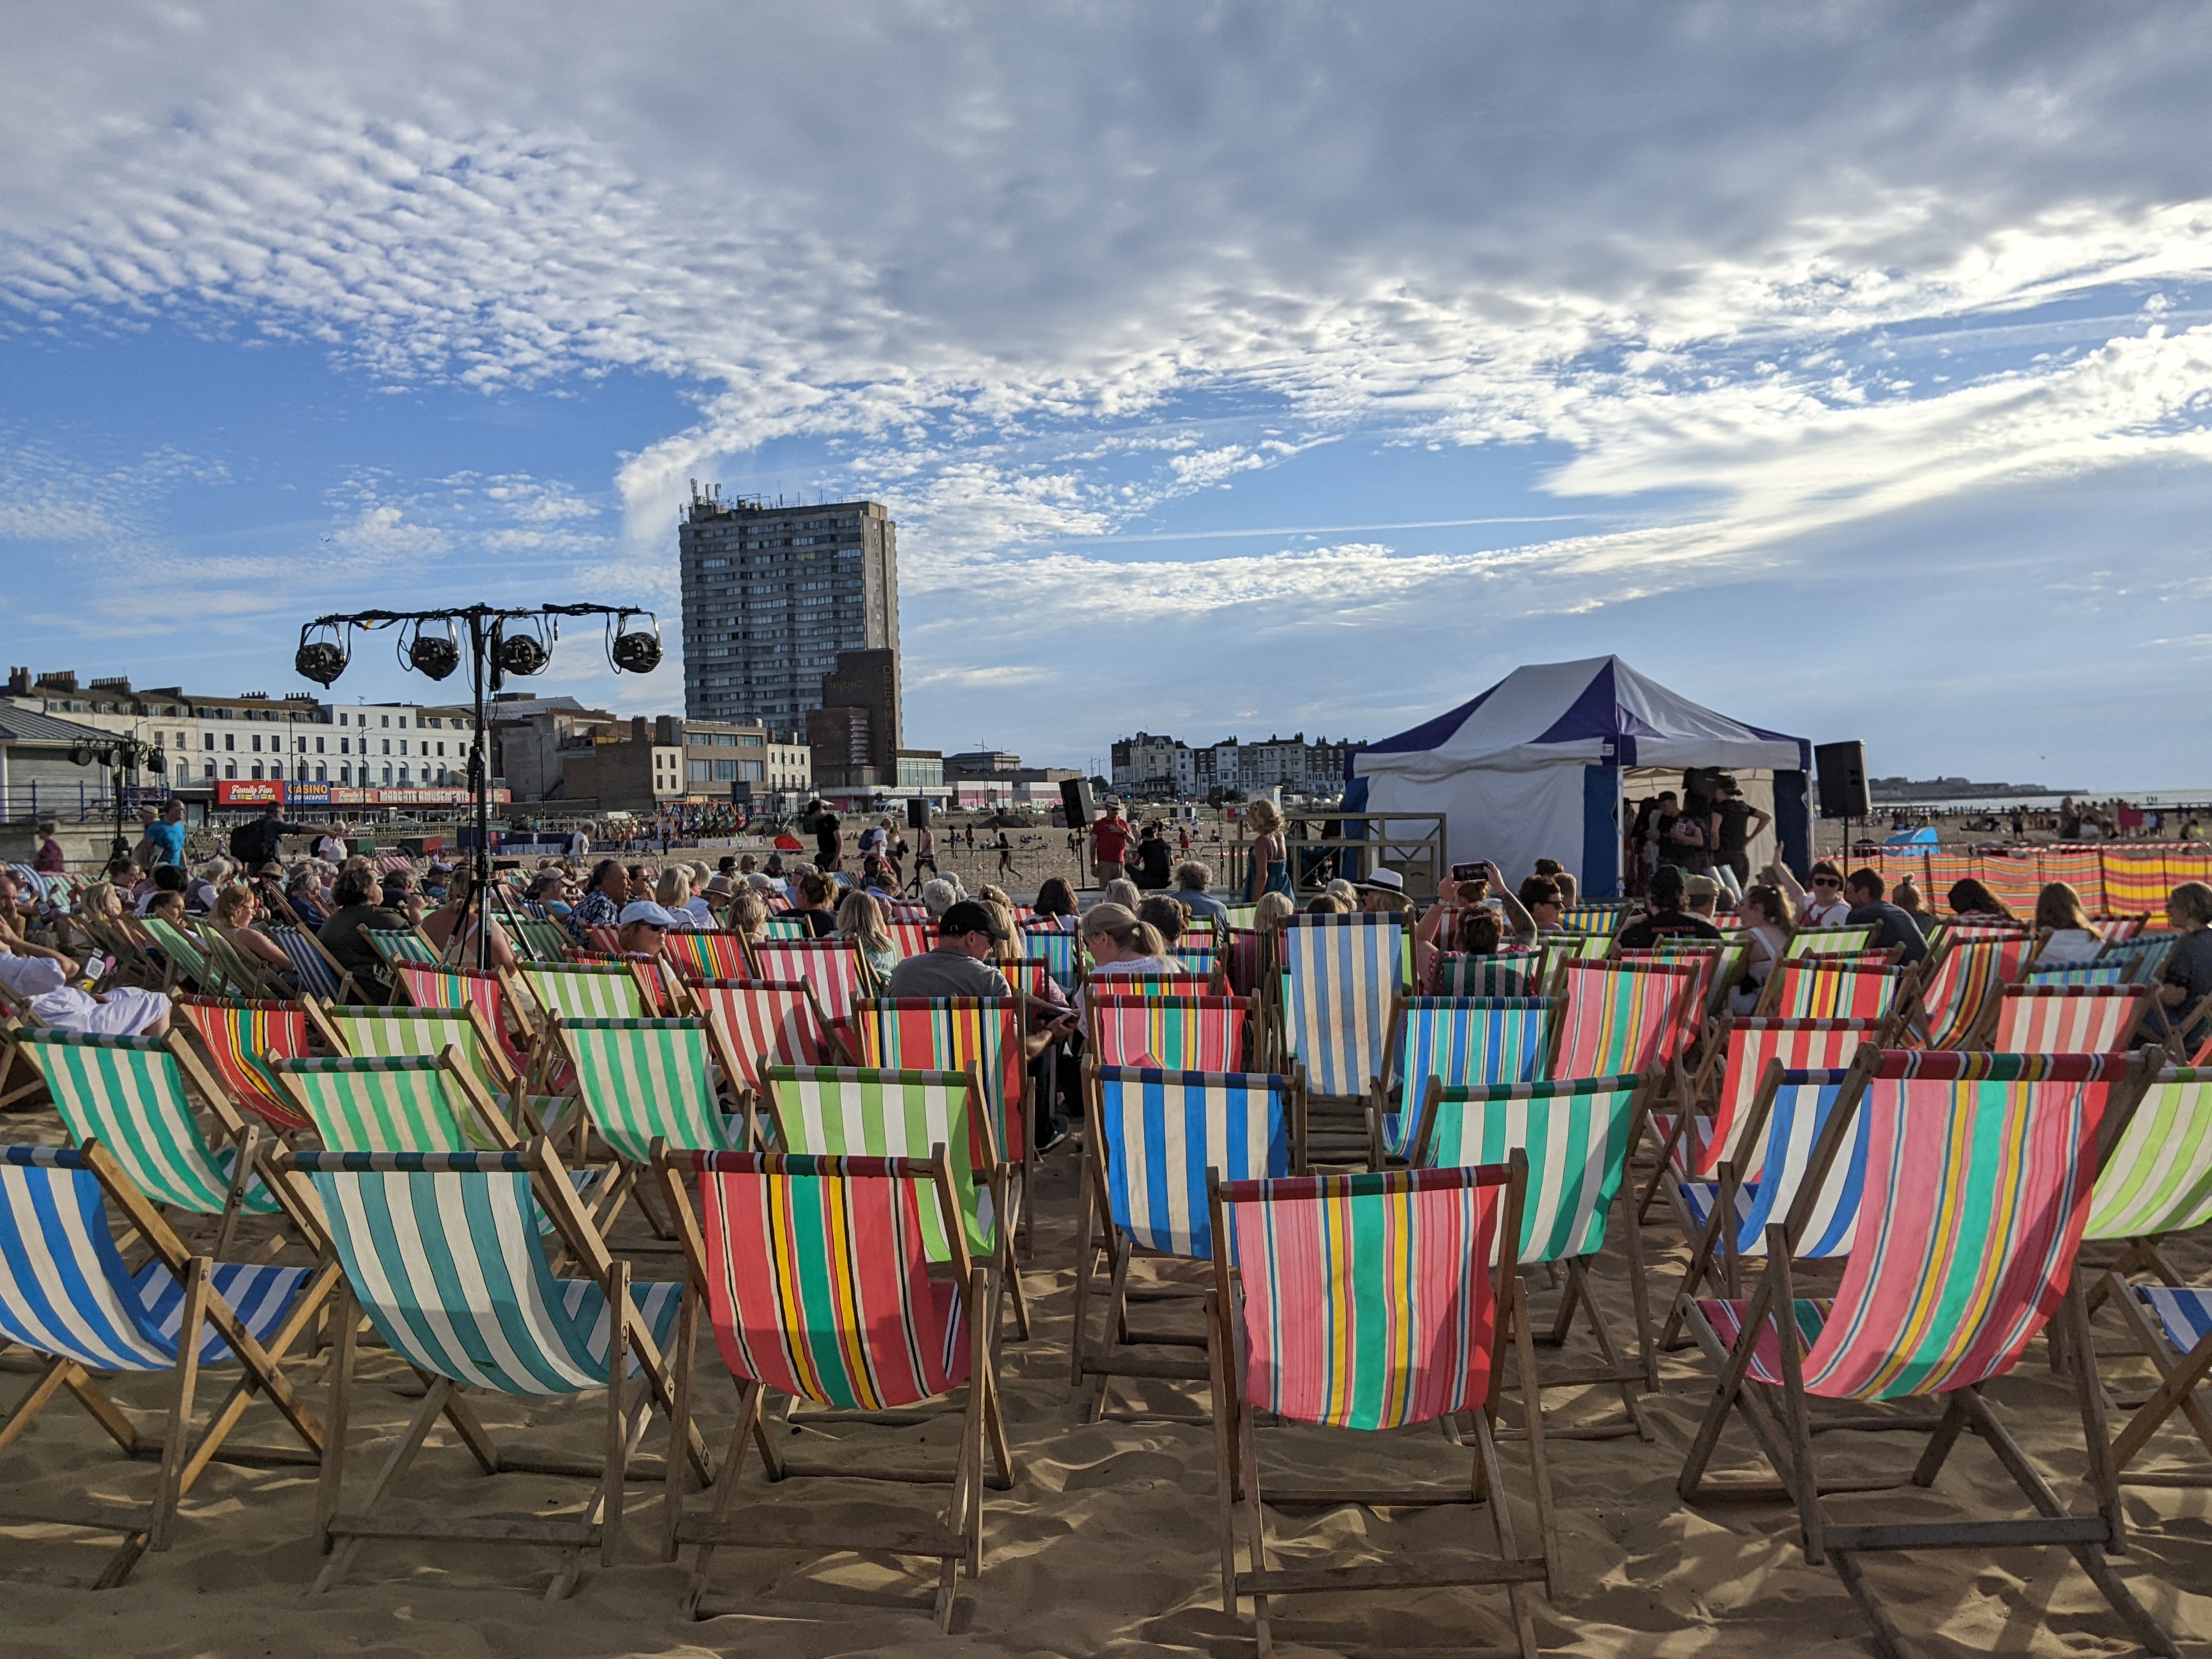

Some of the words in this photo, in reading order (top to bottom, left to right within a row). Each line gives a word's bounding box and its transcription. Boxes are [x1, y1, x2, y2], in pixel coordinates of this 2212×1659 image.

[883, 665, 894, 763] DREAMLAND
[232, 785, 258, 795] Family
[258, 785, 273, 794] Fun
[287, 784, 328, 794] CASINO
[380, 791, 417, 802] MARGATE
